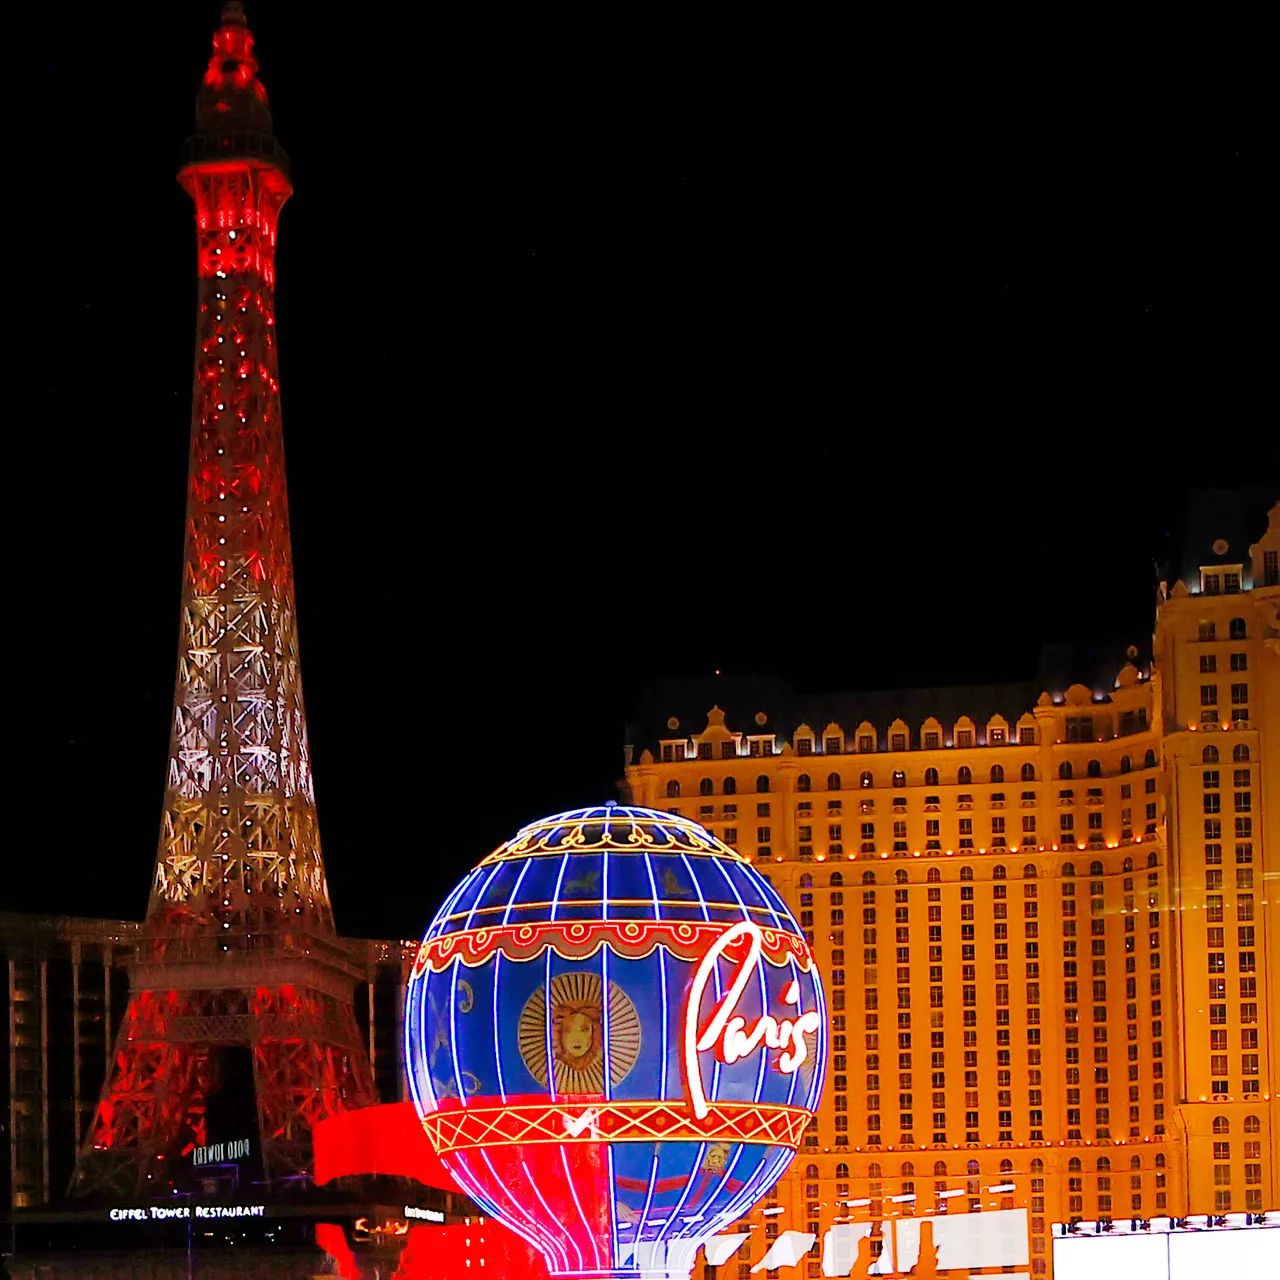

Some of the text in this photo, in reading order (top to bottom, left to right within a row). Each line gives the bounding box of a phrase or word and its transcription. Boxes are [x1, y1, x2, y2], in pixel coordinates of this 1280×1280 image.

[686, 921, 820, 1119] Paris
[150, 1206, 190, 1219] TOWER
[195, 1206, 265, 1218] RESTAURANT
